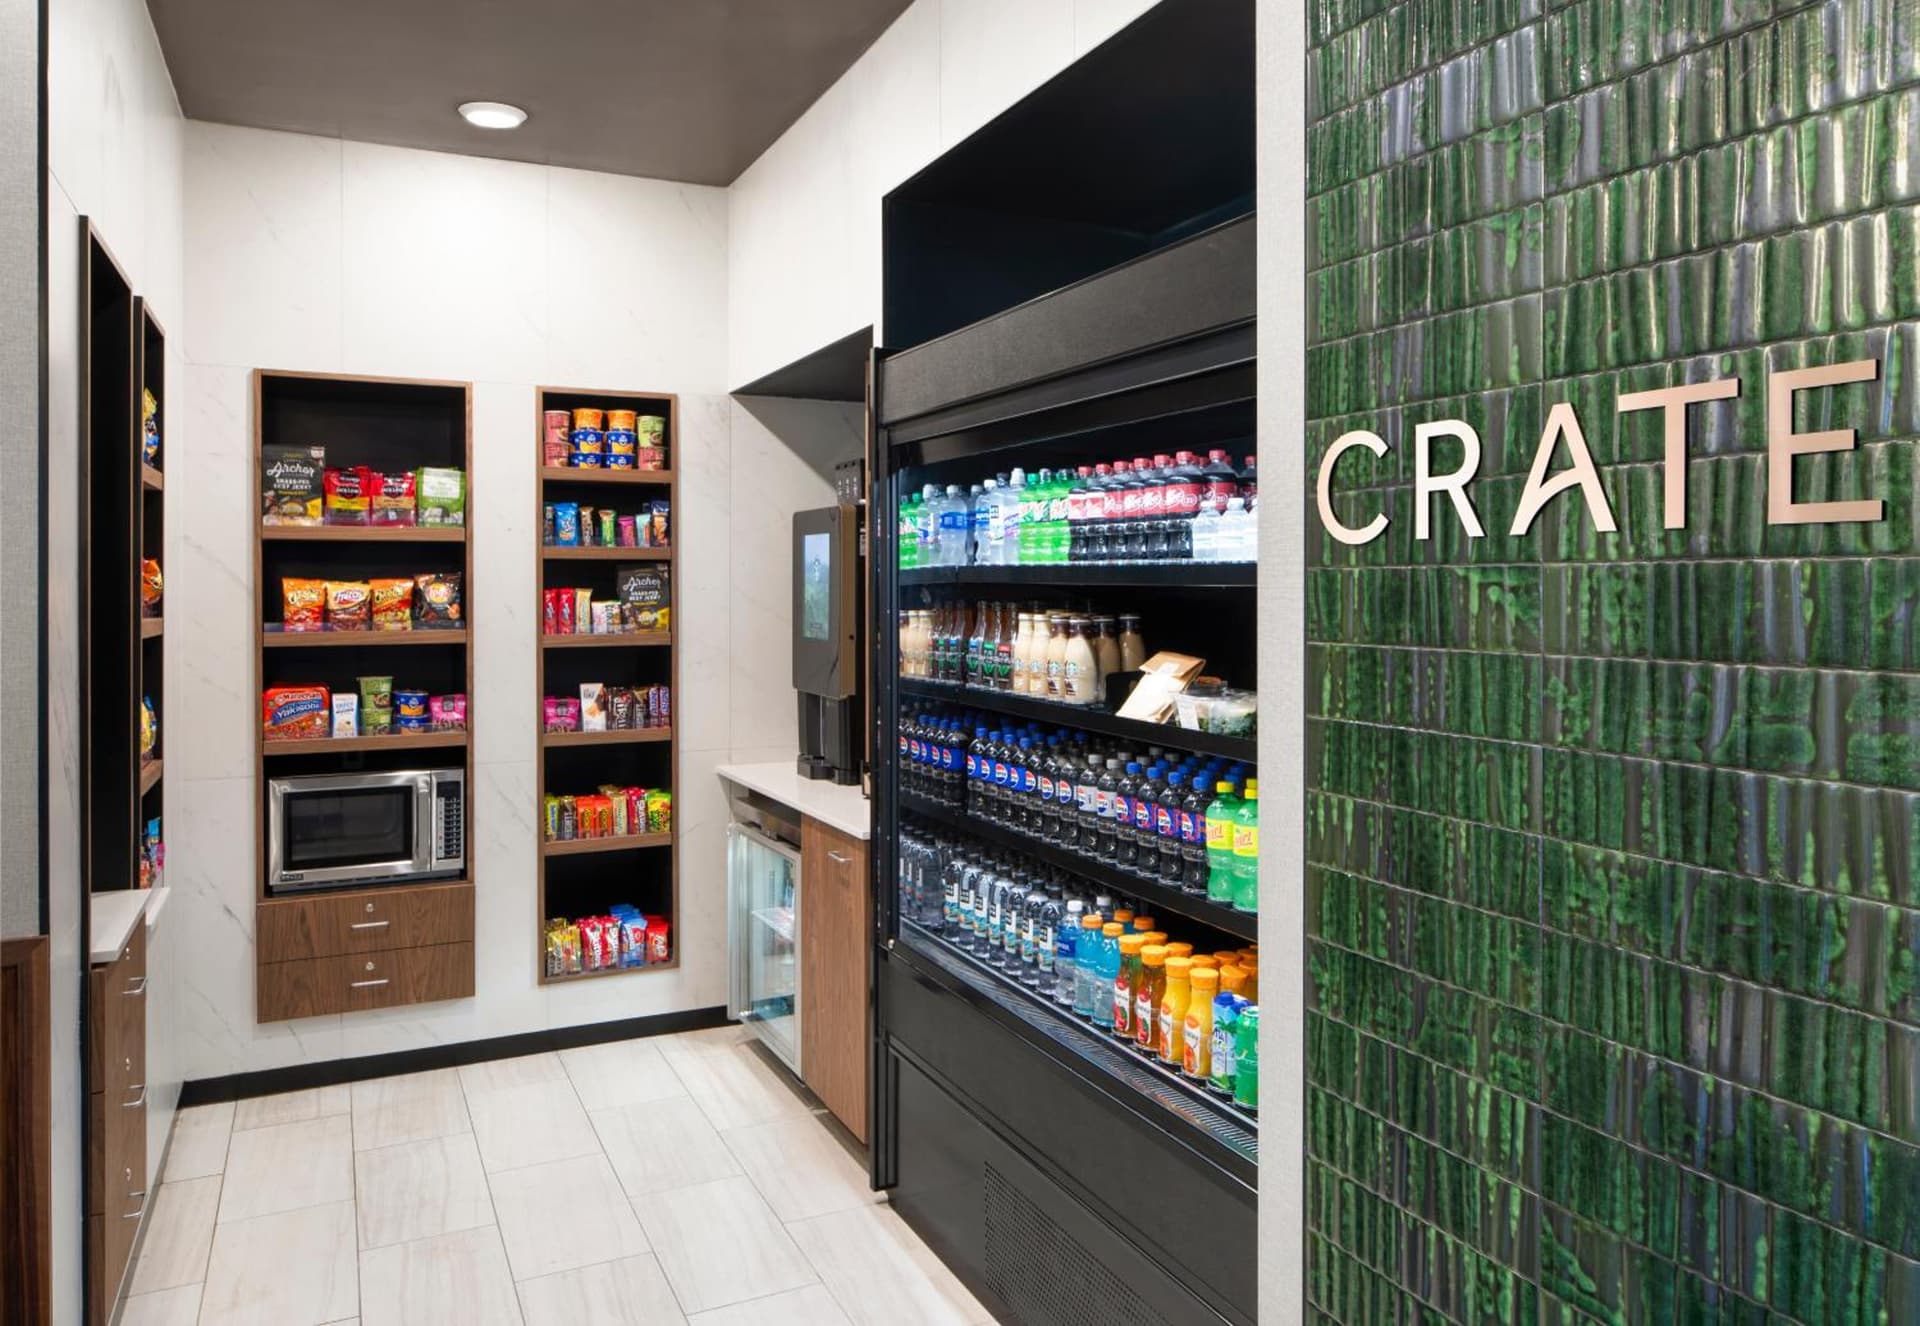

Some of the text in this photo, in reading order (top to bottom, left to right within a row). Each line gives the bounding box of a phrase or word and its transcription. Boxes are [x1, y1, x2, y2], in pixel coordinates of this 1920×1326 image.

[1317, 359, 1883, 544] CRATE
[266, 461, 315, 478] Archer
[277, 702, 321, 719] Yakisoba
